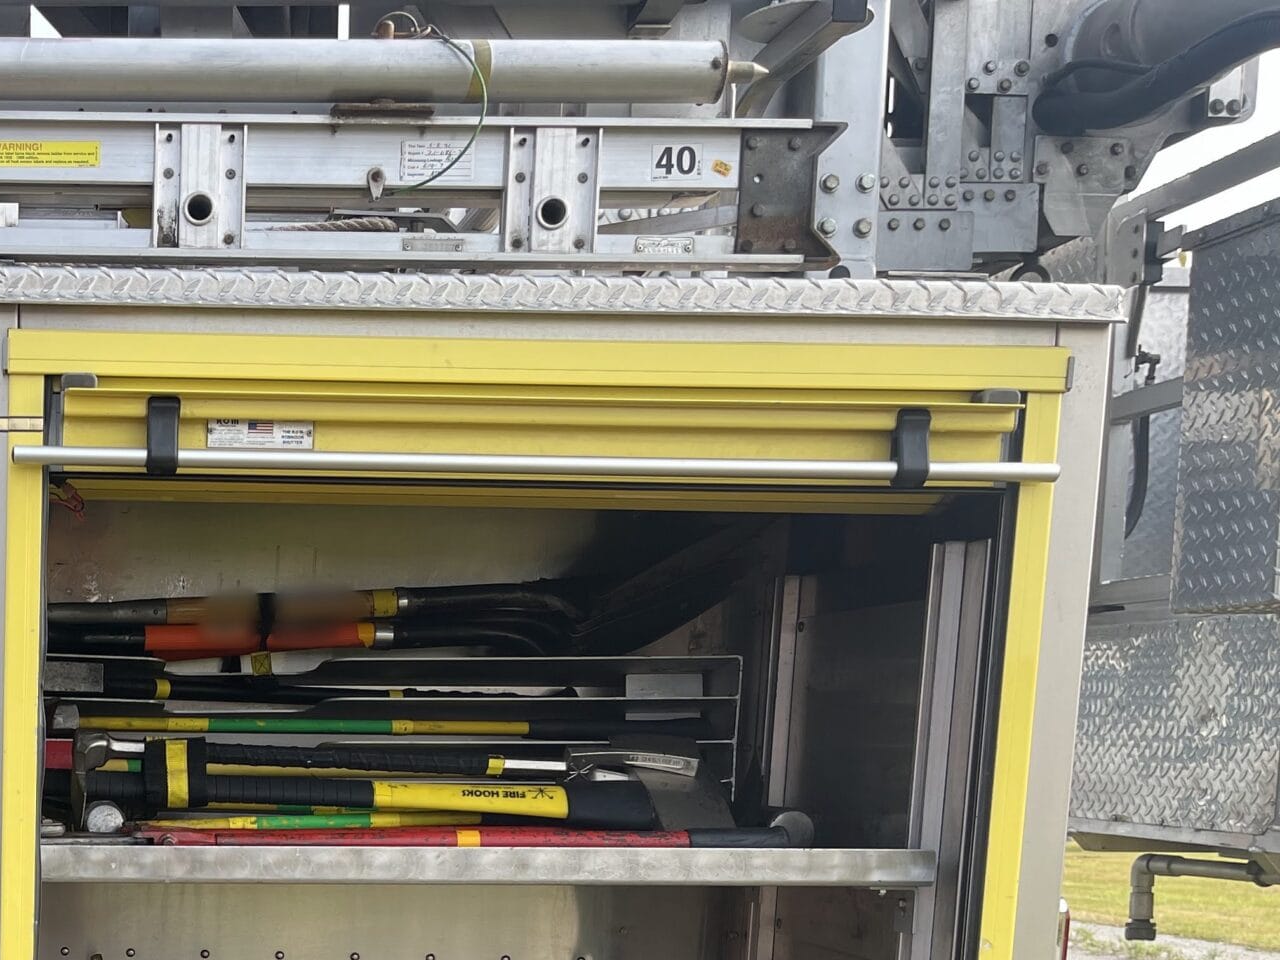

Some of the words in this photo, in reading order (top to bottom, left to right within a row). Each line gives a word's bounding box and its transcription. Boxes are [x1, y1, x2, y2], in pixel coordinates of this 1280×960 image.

[655, 146, 697, 175] 40
[462, 789, 500, 798] HOOKS
[502, 790, 526, 798] FIRE
